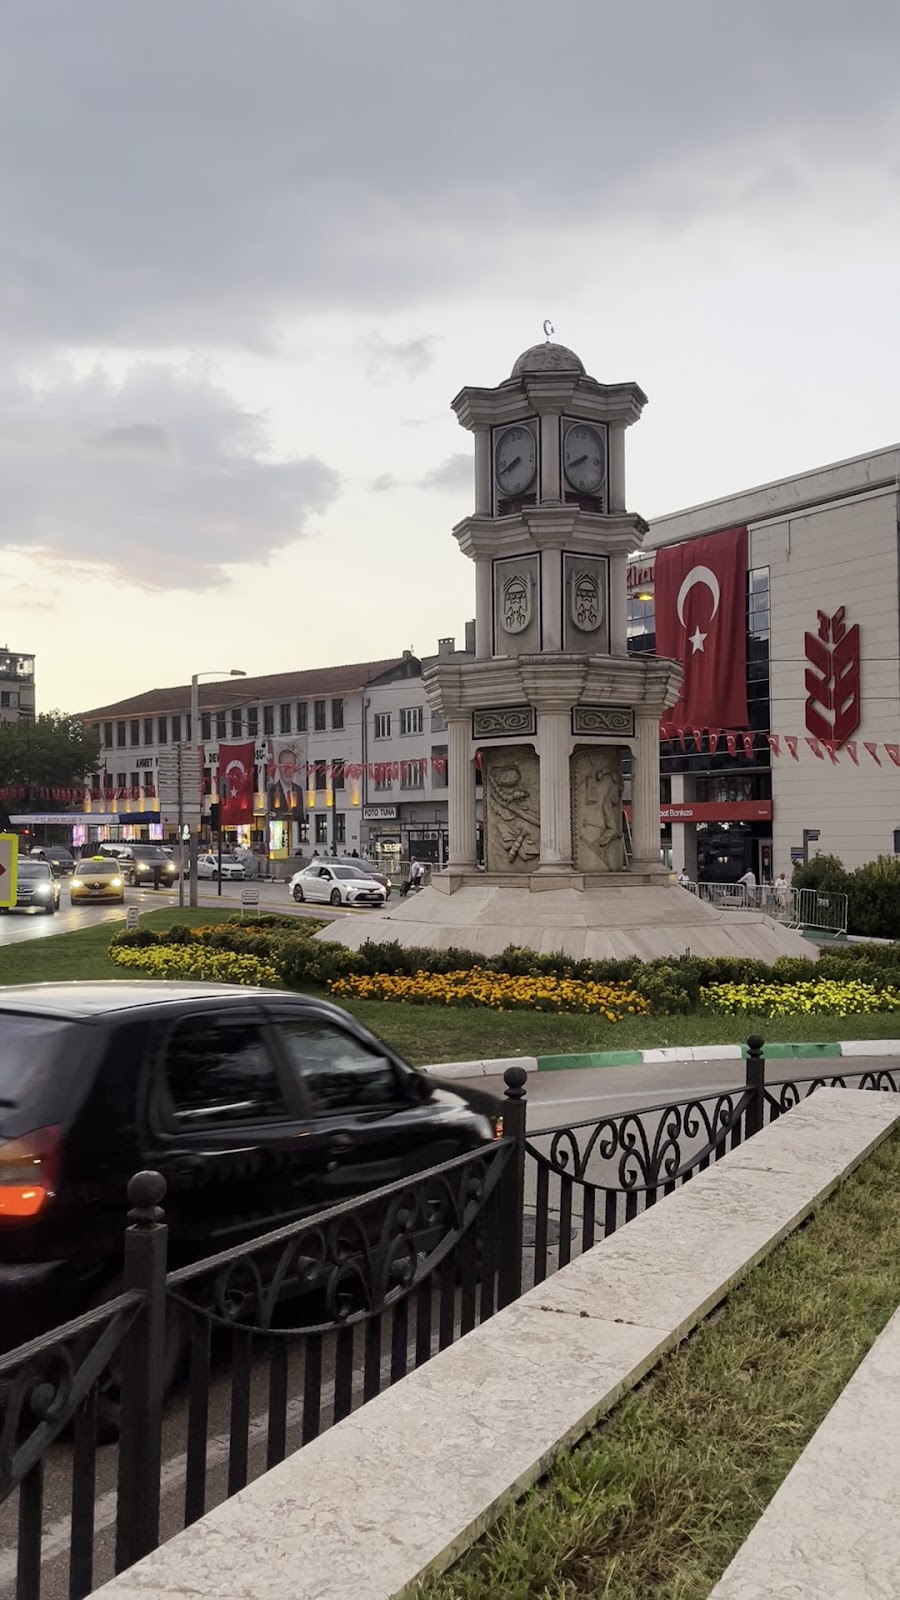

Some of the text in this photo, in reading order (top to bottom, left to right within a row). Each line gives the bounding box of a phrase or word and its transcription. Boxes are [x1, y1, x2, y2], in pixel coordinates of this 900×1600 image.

[512, 431, 522, 441] 12
[575, 430, 587, 439] 12
[529, 454, 534, 462] 3
[593, 458, 599, 466] 3
[135, 757, 153, 768] AHMET
[364, 808, 395, 818] FOTO TUNA
